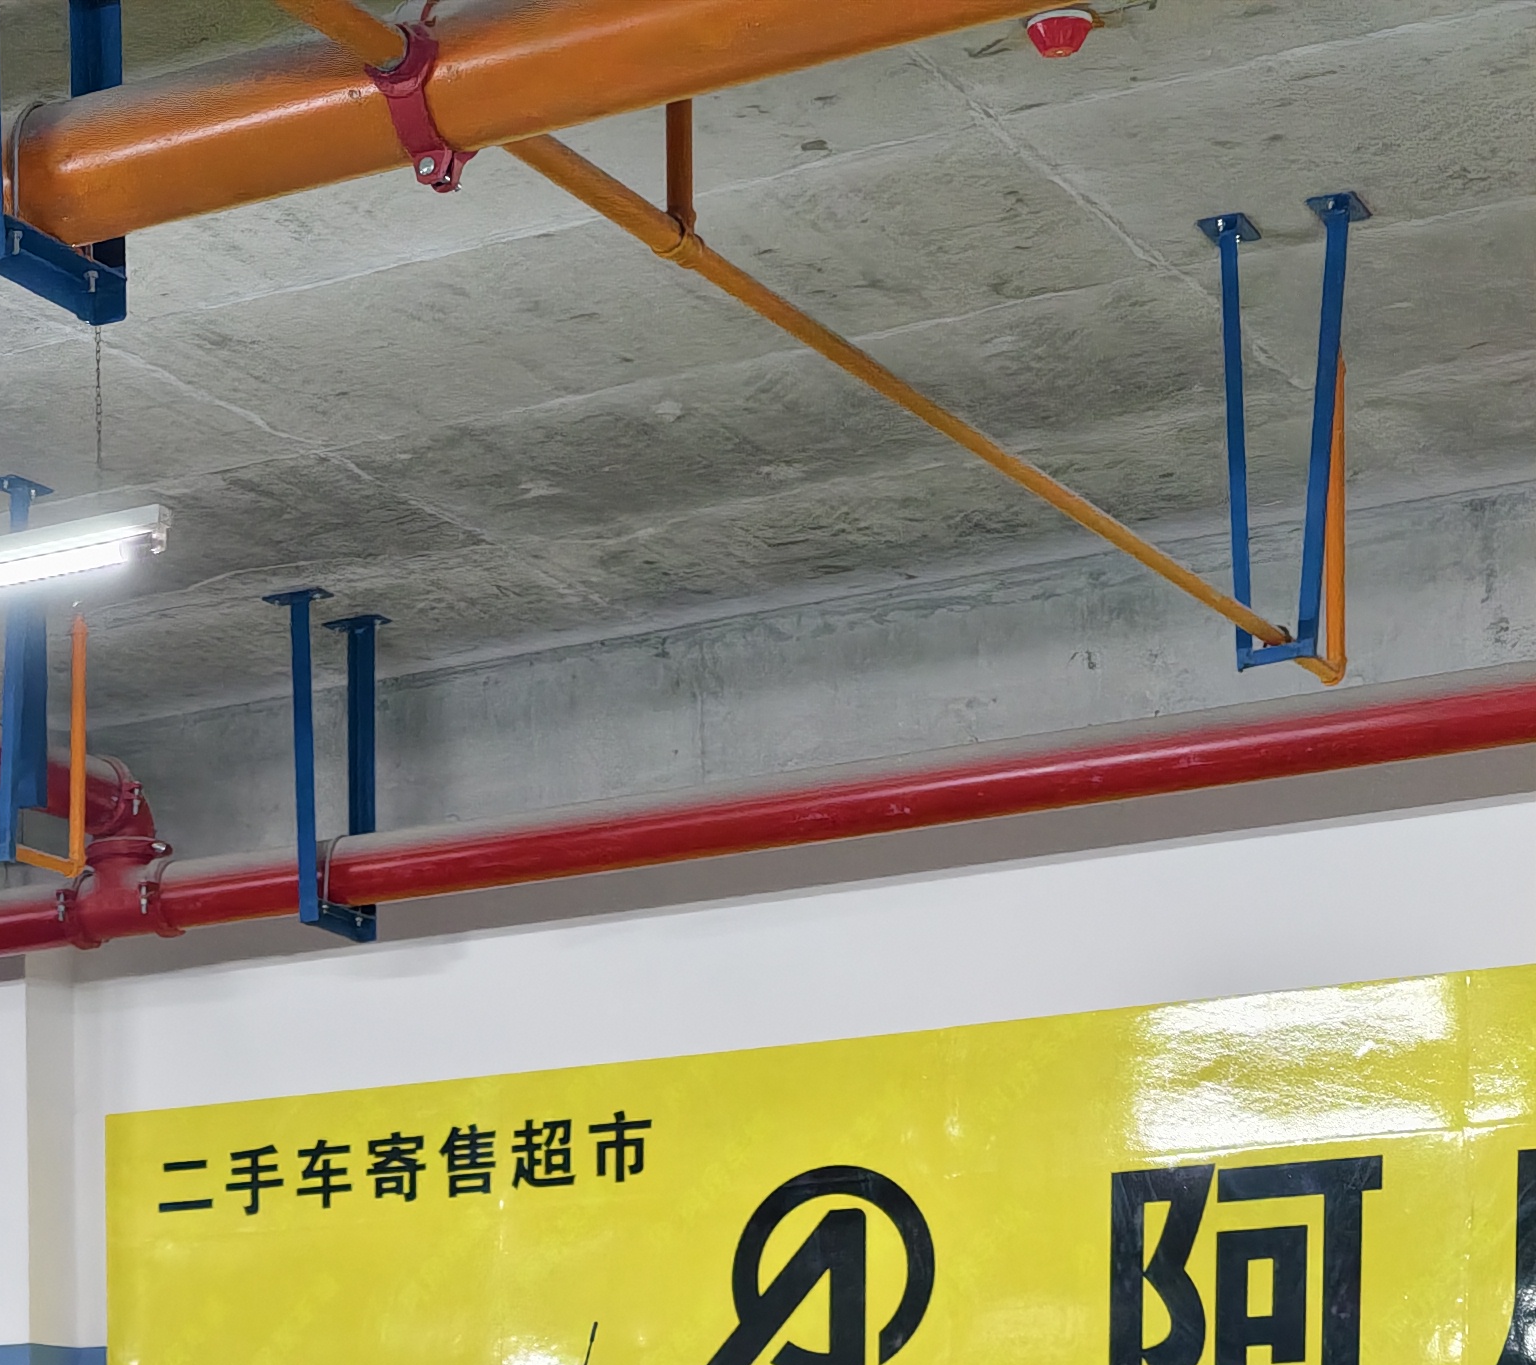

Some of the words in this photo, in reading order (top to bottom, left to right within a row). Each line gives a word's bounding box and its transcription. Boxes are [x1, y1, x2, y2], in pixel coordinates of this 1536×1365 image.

[158, 1111, 652, 1215] 二手车寄售超市
